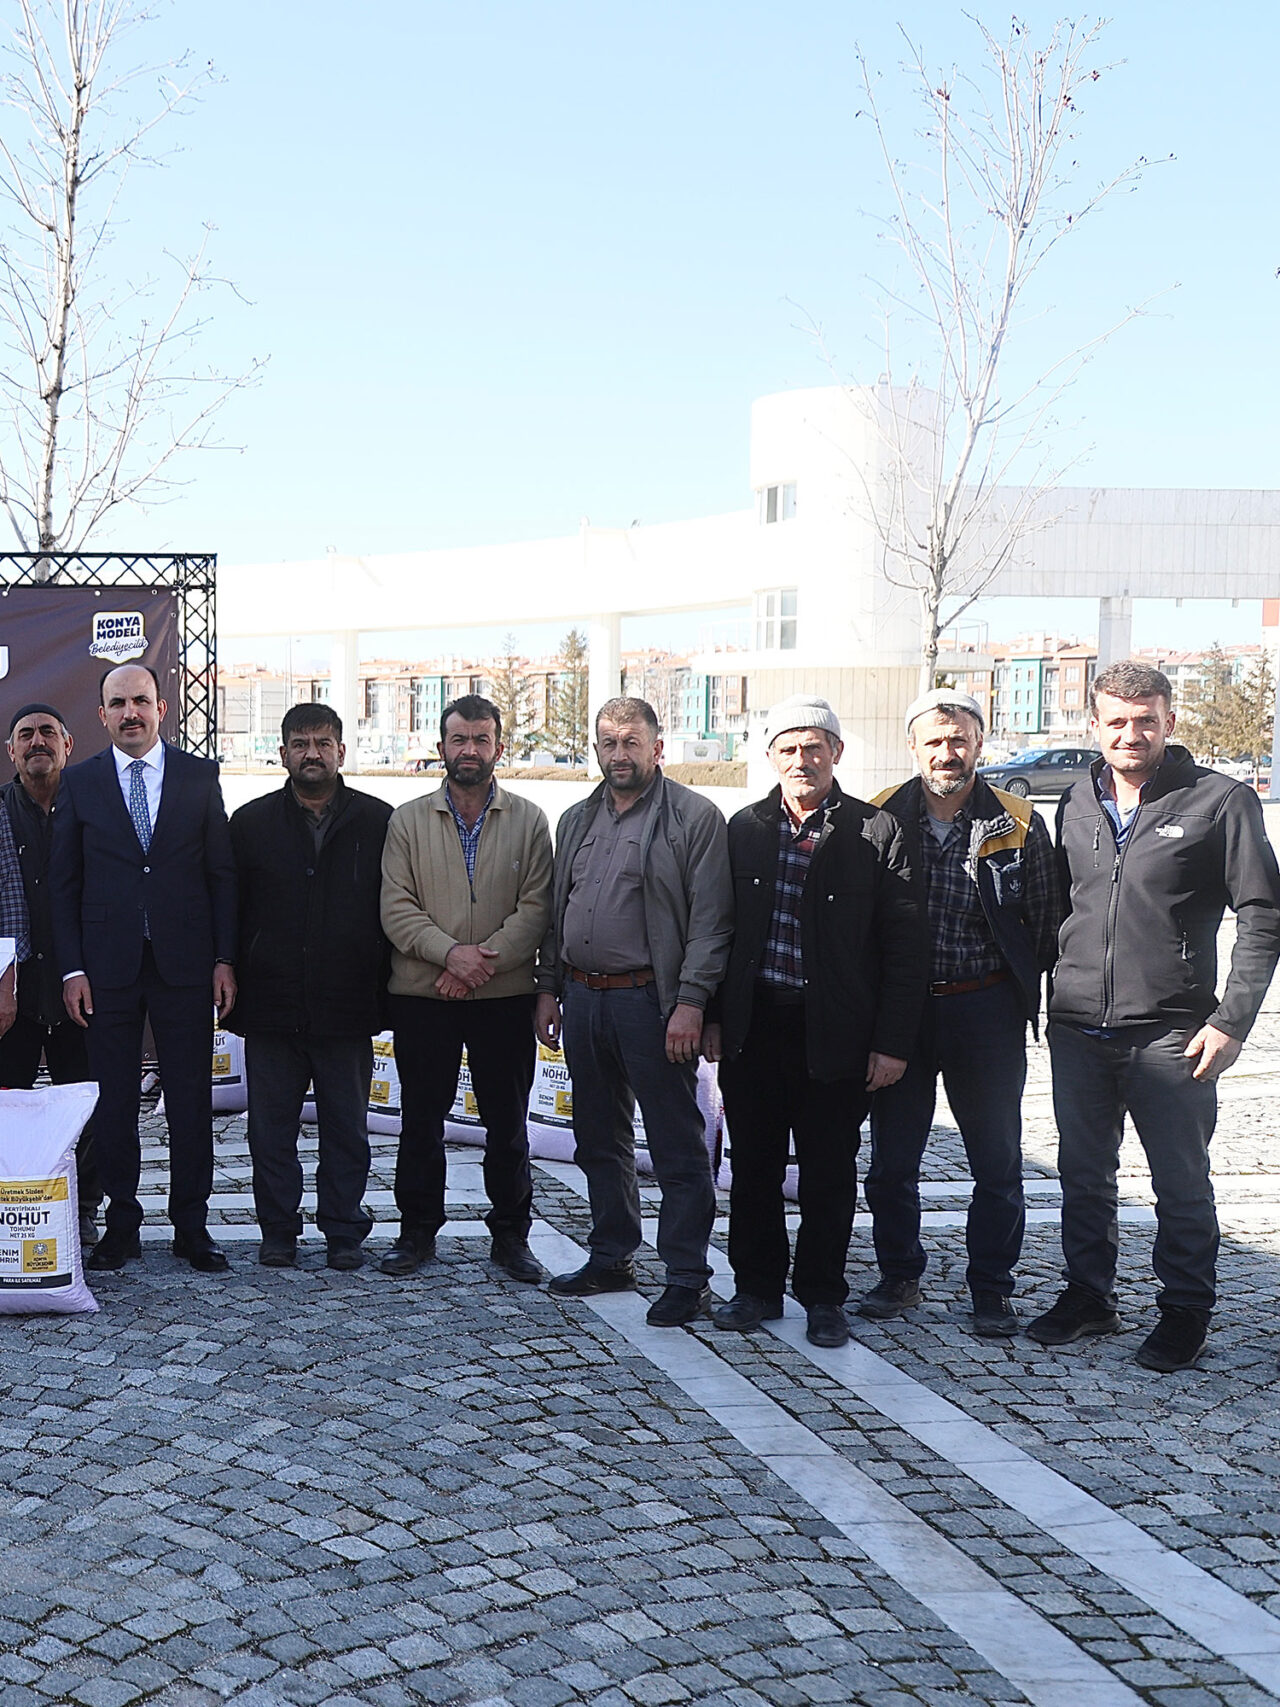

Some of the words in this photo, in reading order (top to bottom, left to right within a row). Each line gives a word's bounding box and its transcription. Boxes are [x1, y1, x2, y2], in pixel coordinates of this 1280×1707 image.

[97, 616, 140, 630] KONYA
[97, 627, 140, 640] MODELİ
[542, 1067, 571, 1081] NOHU
